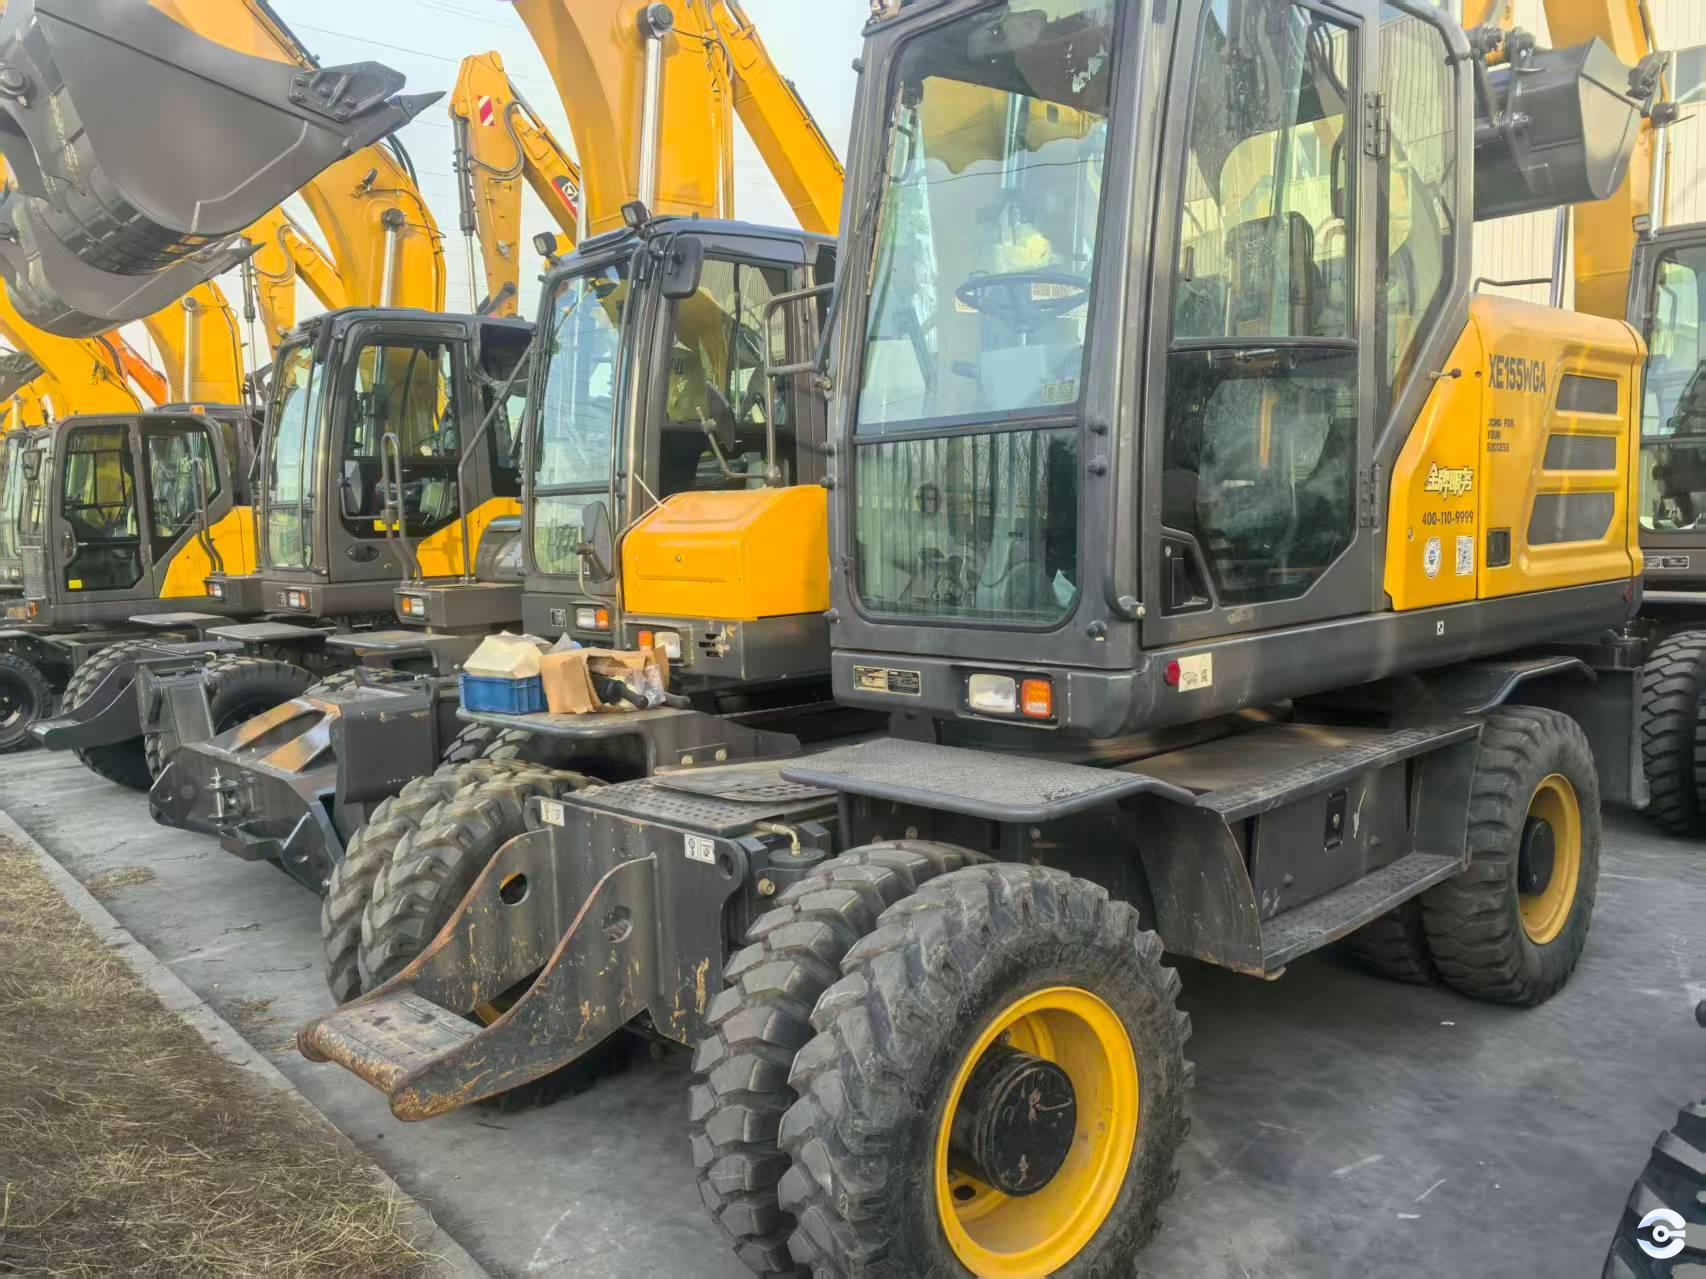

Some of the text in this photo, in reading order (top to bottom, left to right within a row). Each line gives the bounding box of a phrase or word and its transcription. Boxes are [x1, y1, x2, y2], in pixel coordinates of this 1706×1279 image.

[1488, 353, 1546, 393] XE155WGA
[1487, 442, 1510, 453] SUCCESS
[1422, 510, 1474, 526] 400-110-9999
